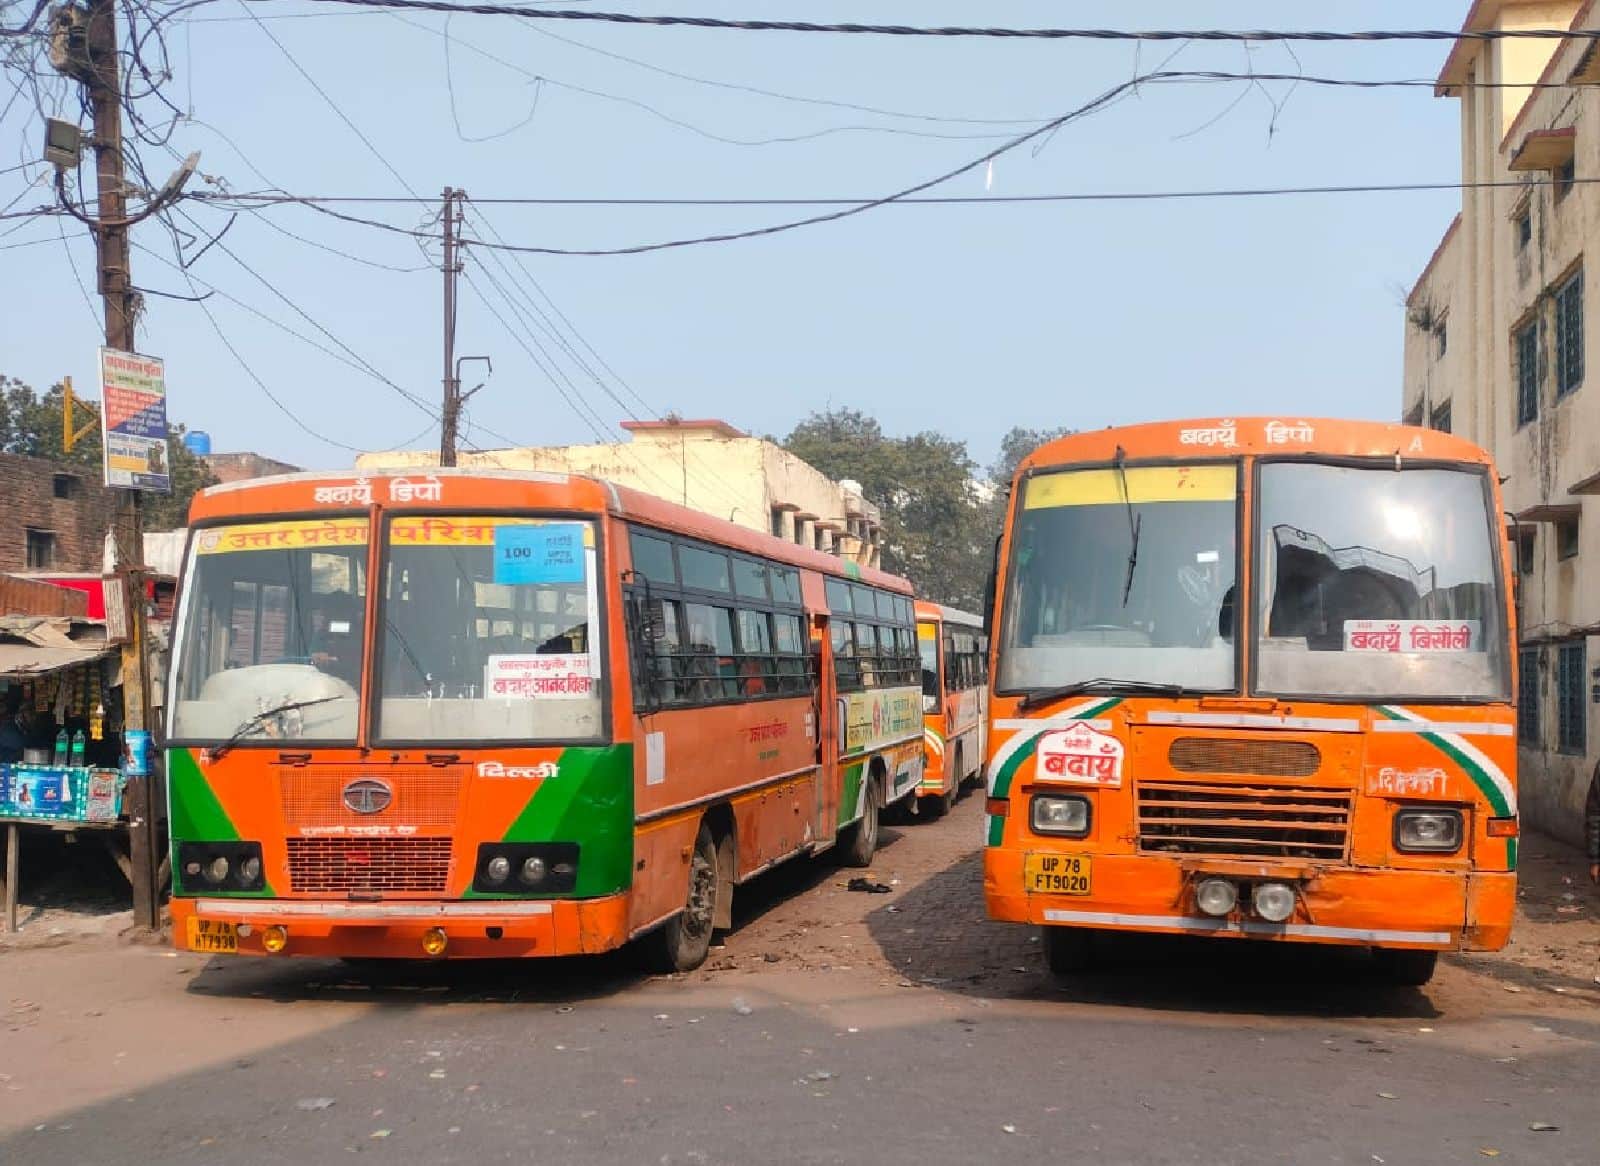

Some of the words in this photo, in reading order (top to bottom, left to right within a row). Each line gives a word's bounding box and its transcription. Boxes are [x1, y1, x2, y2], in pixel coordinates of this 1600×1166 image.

[1264, 420, 1314, 444] डिपो
[1408, 434, 1423, 452] A
[389, 474, 443, 502] डिपो
[229, 529, 294, 548] उत्तर
[504, 547, 532, 559] 100
[1410, 624, 1472, 649] बिसौली
[477, 761, 560, 778] दिल्ली
[1042, 858, 1059, 872] UP
[1065, 858, 1080, 873] 78
[1036, 874, 1088, 891] FT9020
